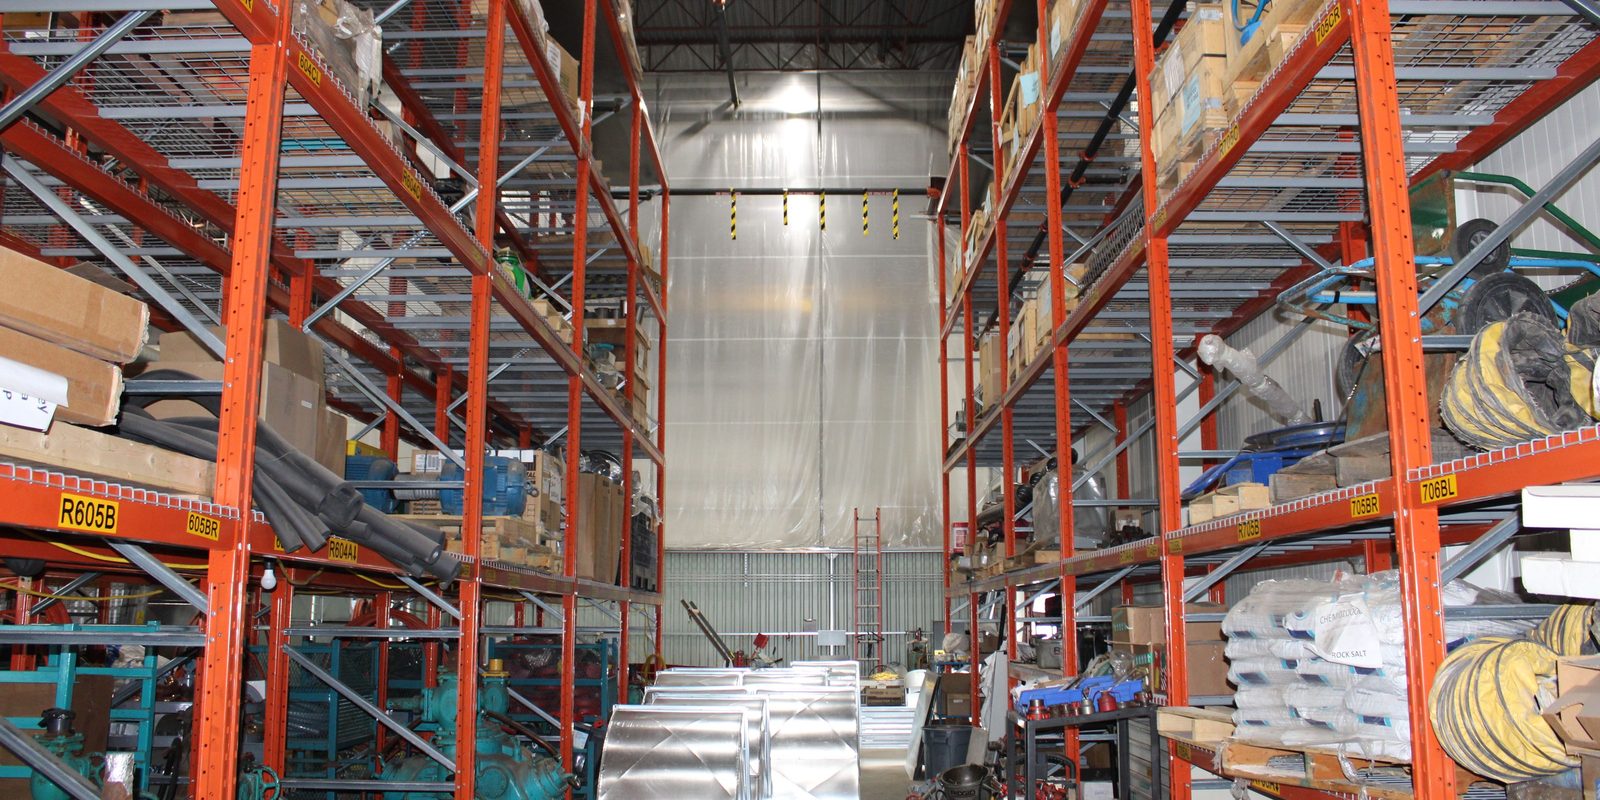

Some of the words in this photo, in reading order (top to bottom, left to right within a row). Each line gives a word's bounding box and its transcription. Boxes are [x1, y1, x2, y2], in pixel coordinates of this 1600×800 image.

[1317, 7, 1340, 42] 705CR
[300, 55, 320, 85] 604CL
[1422, 478, 1455, 501] 706BL
[61, 498, 116, 530] R605B
[1352, 496, 1379, 515] 705BR
[189, 514, 218, 537] 605BR
[1238, 520, 1260, 539] R705B
[1332, 651, 1350, 659] ROCK
[1350, 650, 1367, 658] SALT
